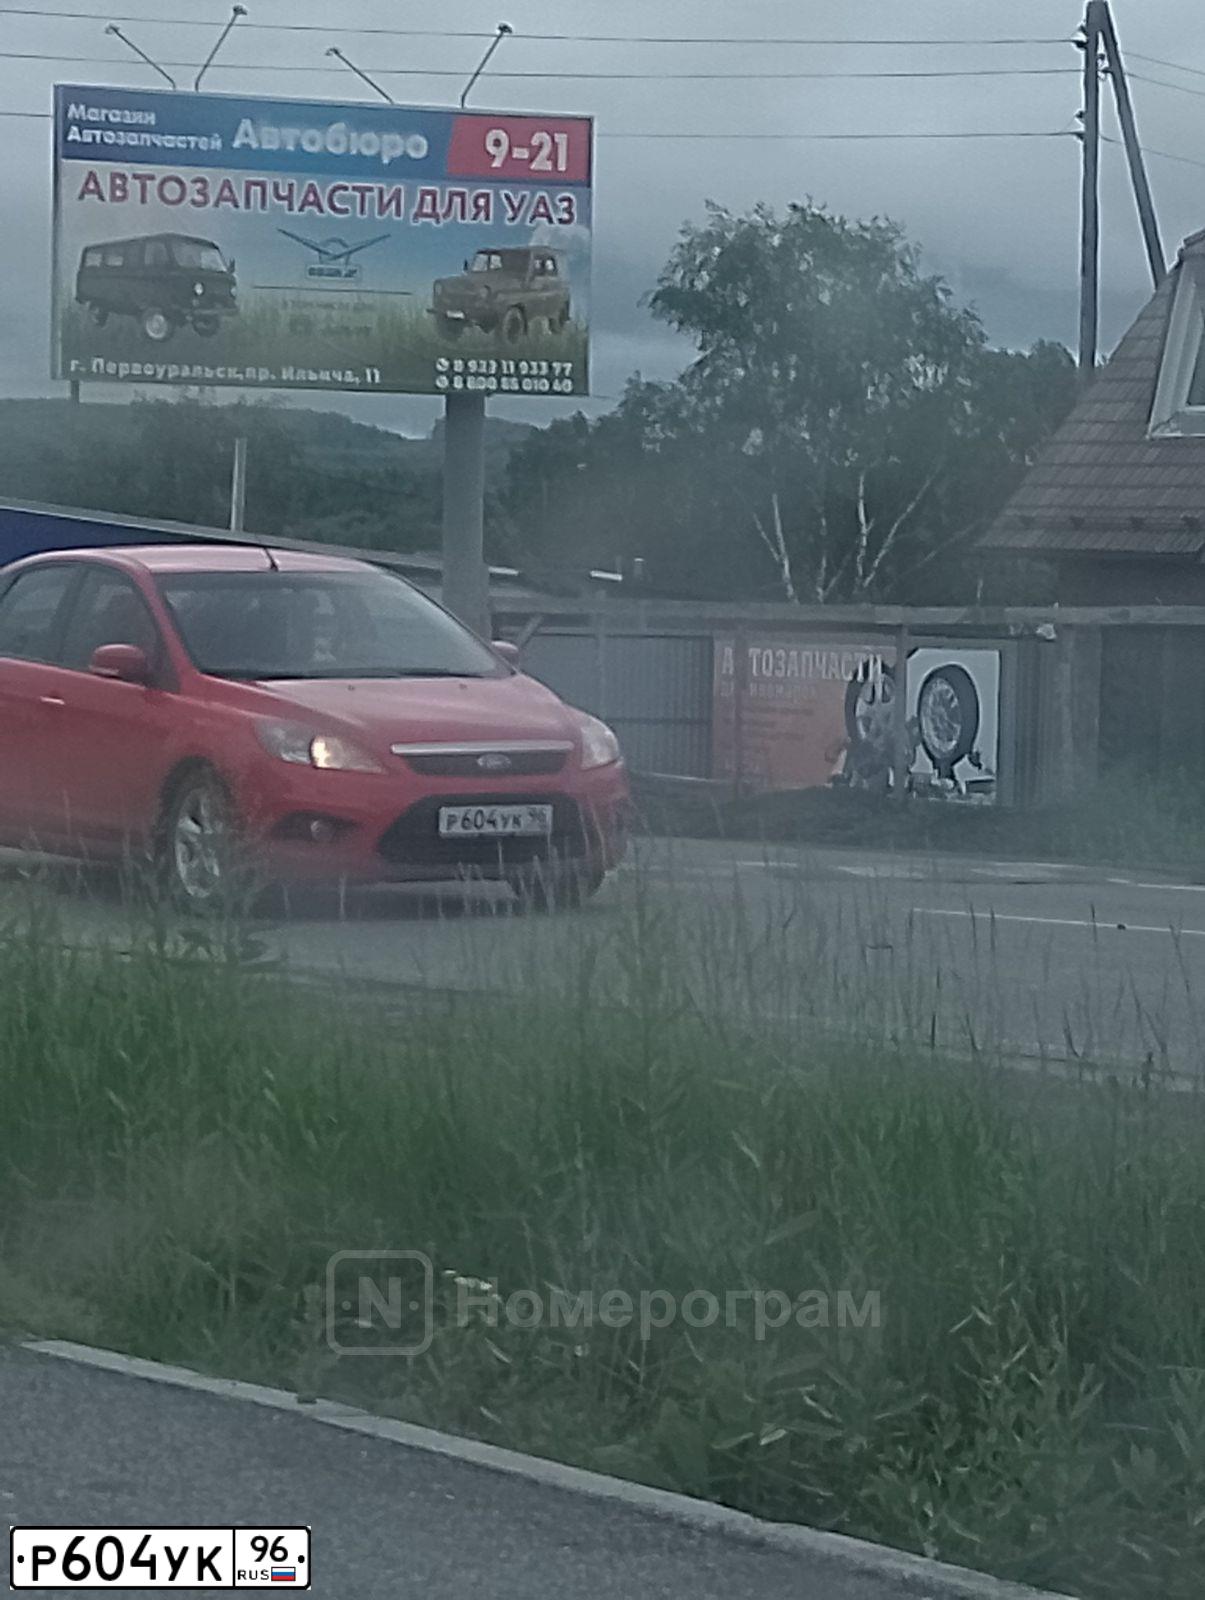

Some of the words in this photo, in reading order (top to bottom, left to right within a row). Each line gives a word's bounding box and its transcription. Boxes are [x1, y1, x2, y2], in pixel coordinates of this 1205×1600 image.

[67, 103, 156, 126] Магазин
[67, 125, 223, 151] Автозапчастей
[232, 117, 429, 165] Автобюро
[485, 128, 568, 172] 9-21
[78, 169, 403, 219] АВТОЗАПЧАСТИ
[411, 187, 492, 225] ДЛЯ
[504, 191, 576, 225] УАЗ
[365, 366, 380, 384] 11
[453, 359, 464, 373] 8
[501, 359, 515, 375] 11
[552, 361, 573, 377] 77
[721, 646, 883, 684] АТОЗАПЧАСТИ
